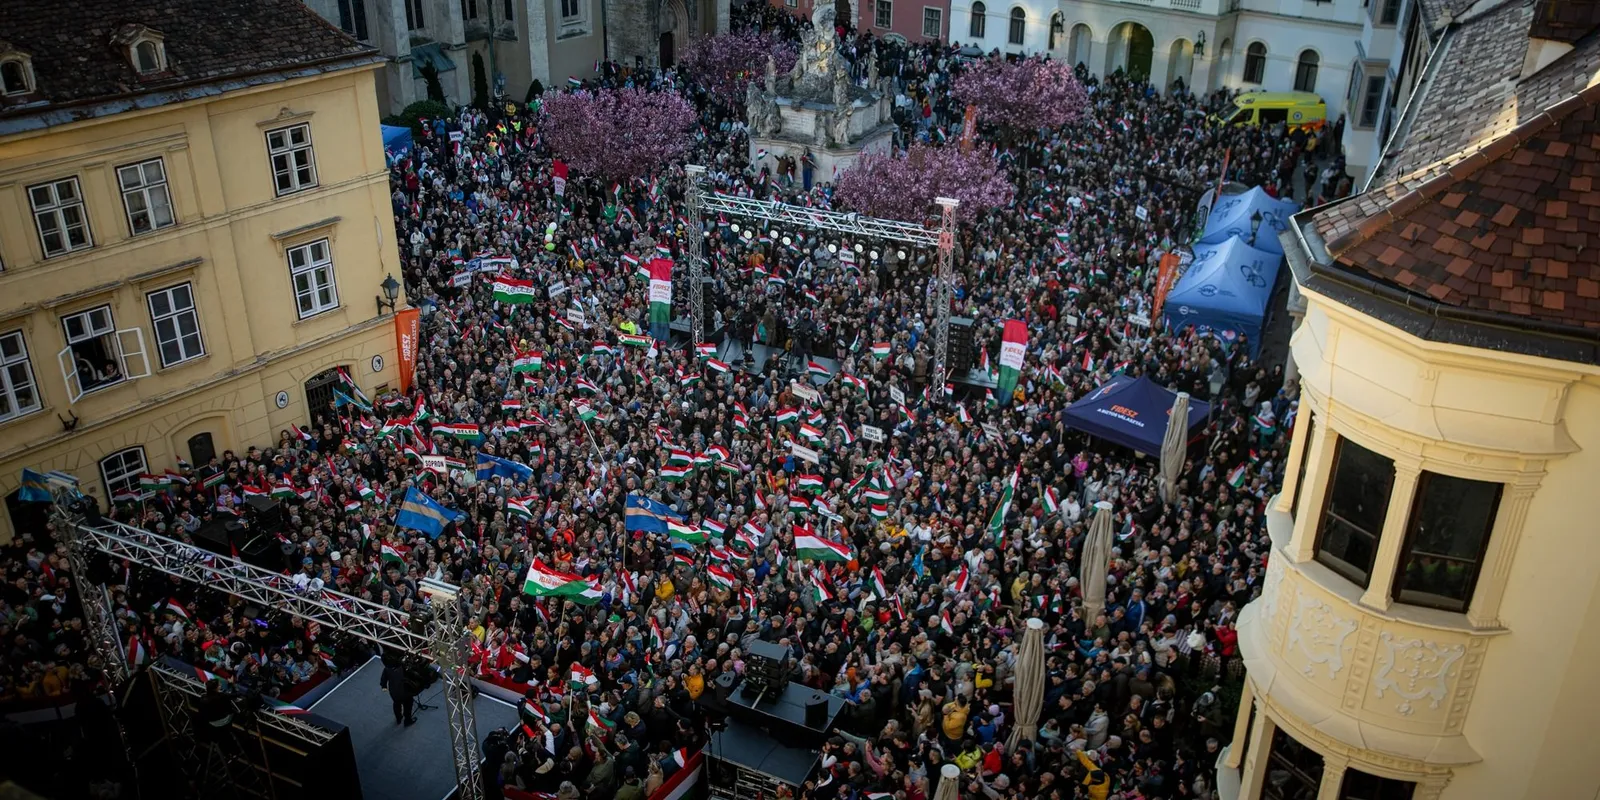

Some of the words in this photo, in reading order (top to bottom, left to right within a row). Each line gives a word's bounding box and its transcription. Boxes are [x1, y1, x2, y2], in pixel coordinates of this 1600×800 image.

[402, 333, 411, 361] FIDESZ
[1102, 409, 1118, 418] BIZTOS
[1118, 414, 1145, 428] VÁLASZTÁS
[1110, 404, 1139, 418] FIDESZ
